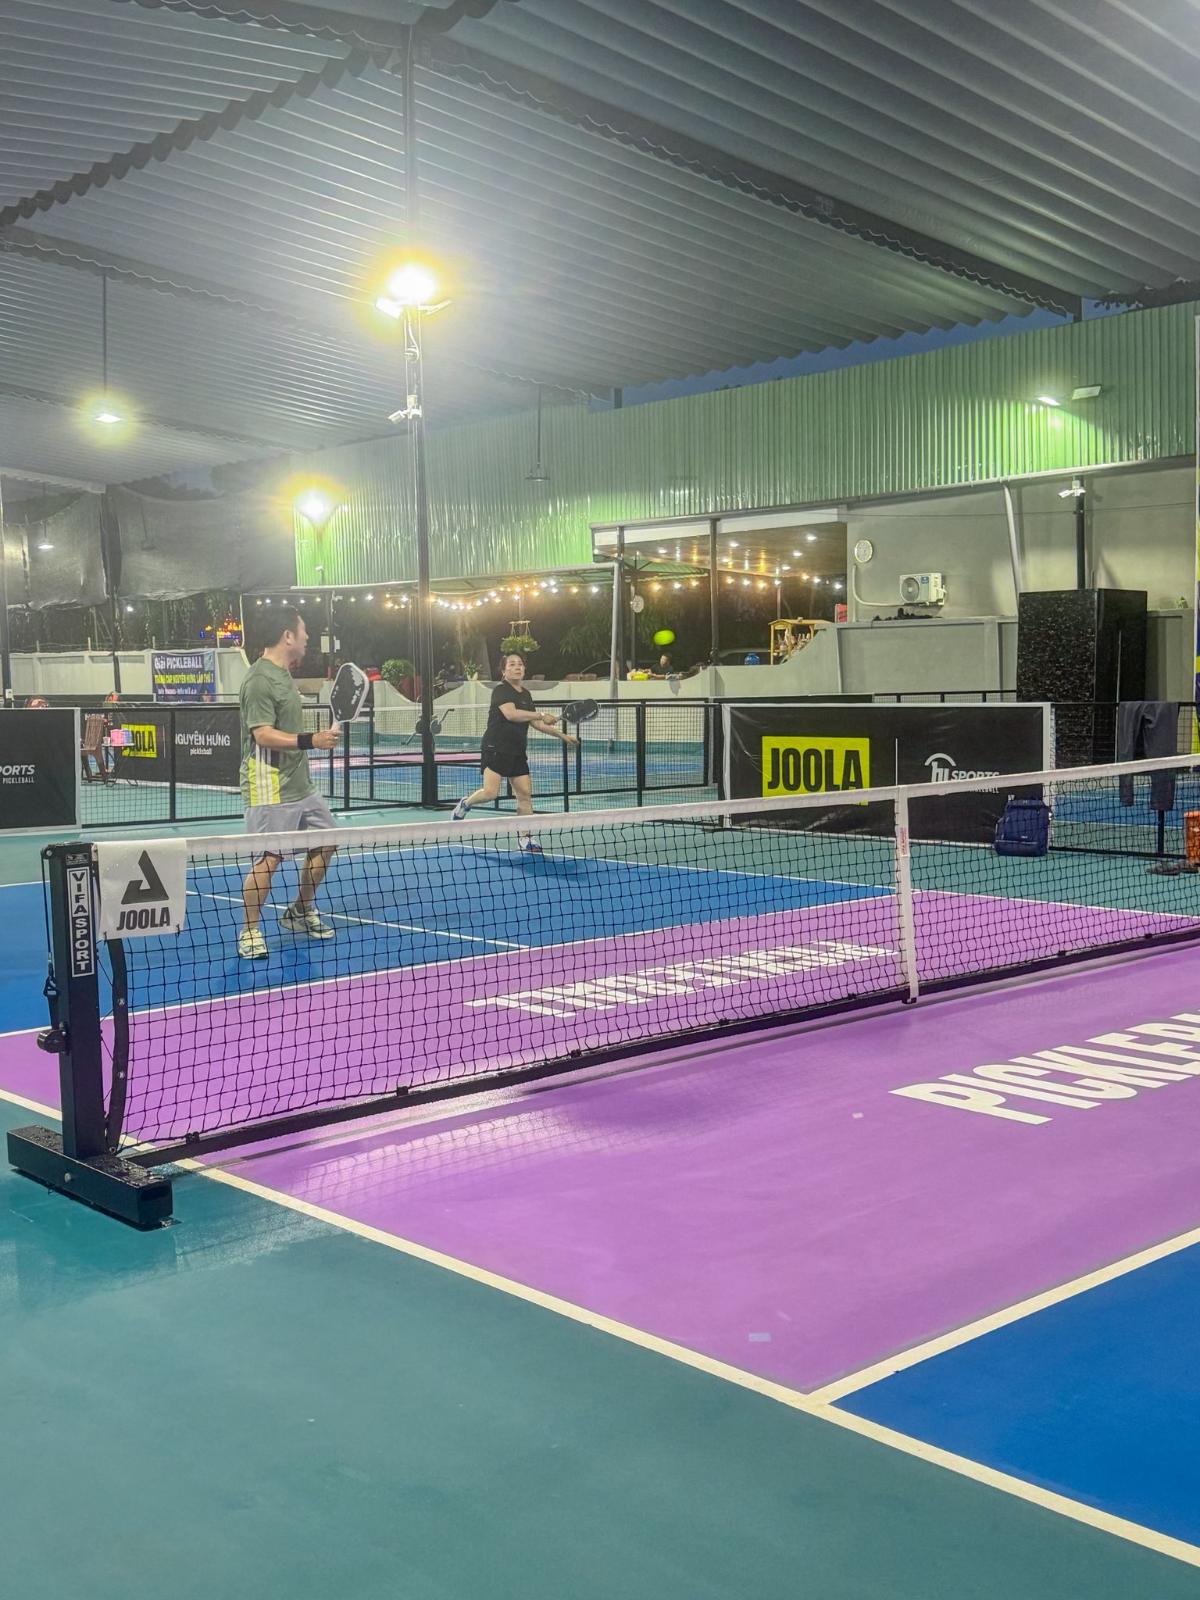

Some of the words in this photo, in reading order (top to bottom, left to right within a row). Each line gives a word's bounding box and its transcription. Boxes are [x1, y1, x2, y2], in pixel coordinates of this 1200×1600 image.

[166, 655, 203, 669] PICKLEBALL
[124, 730, 155, 752] OLA
[206, 732, 231, 747] HƯNG
[0, 764, 36, 776] ORTS
[2, 776, 35, 785] PICKLEBALL
[767, 748, 864, 792] JOOLA
[71, 872, 90, 971] VIFASPORT
[116, 906, 171, 931] JOOLA
[887, 1008, 1200, 1126] PICKLE
